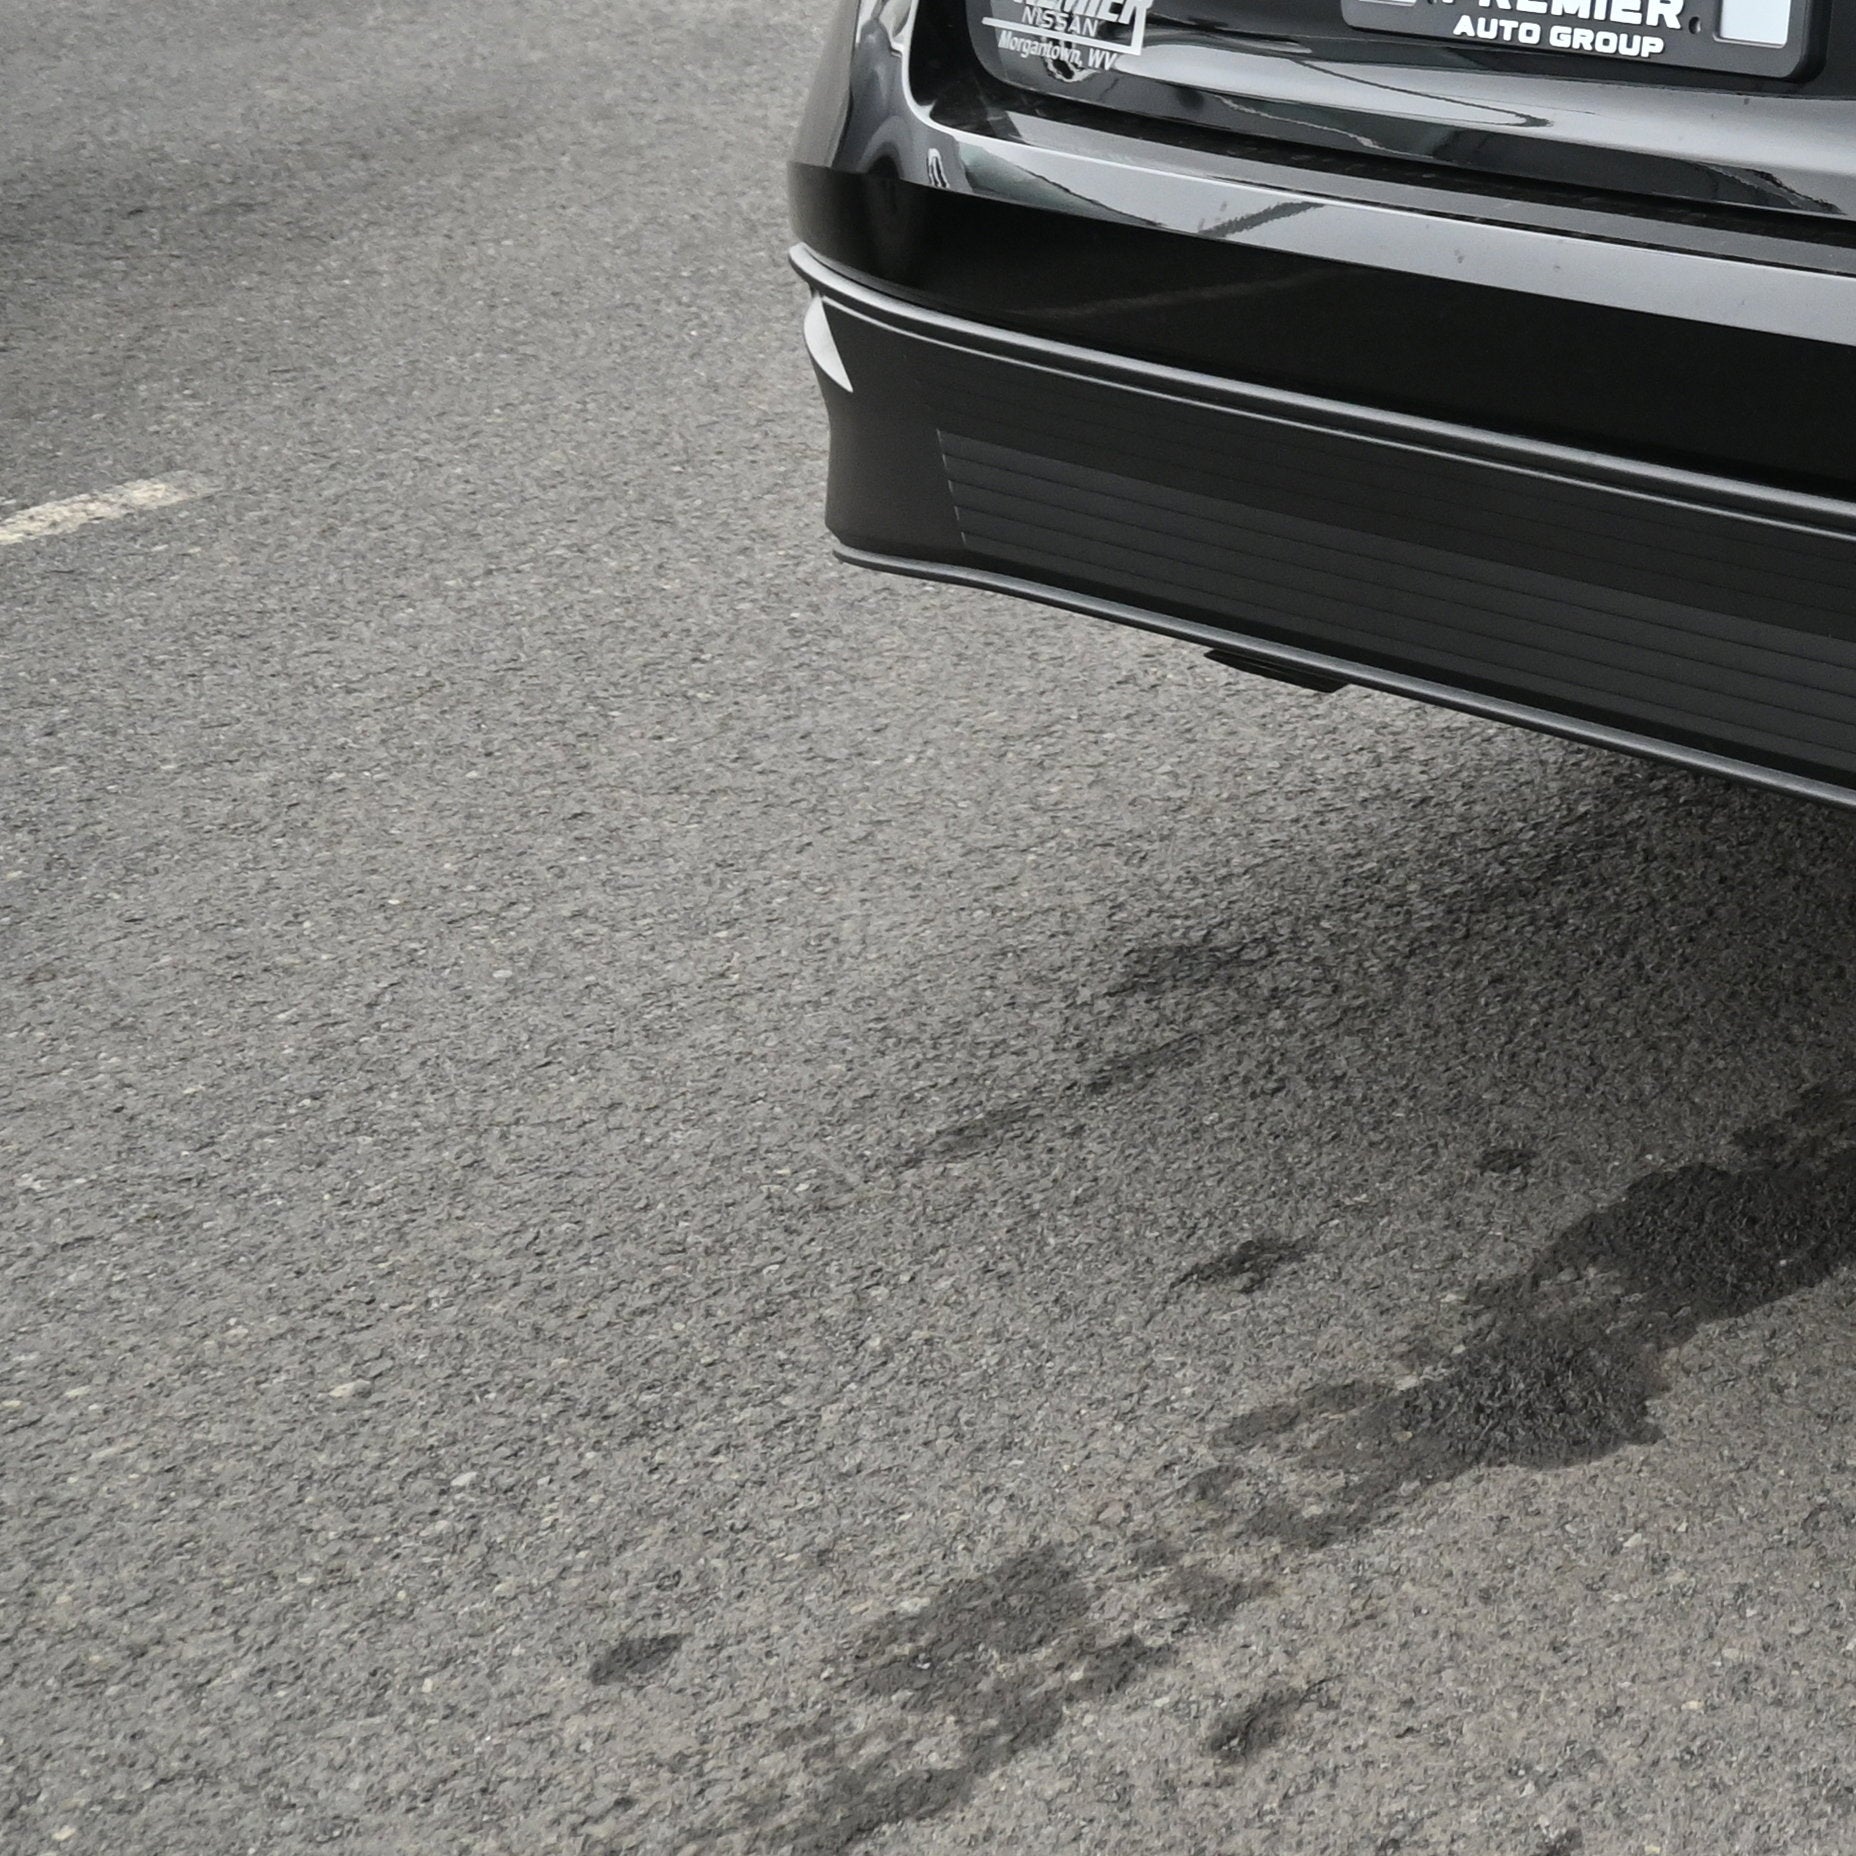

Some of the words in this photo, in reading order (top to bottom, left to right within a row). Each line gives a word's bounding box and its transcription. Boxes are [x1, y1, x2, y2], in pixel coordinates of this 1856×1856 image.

[1022, 6, 1099, 37] NISSAN
[1453, 14, 1541, 45] AUTO
[1549, 25, 1664, 58] GROUP
[998, 30, 1083, 68] Morgantown,
[1088, 47, 1118, 71] WV
